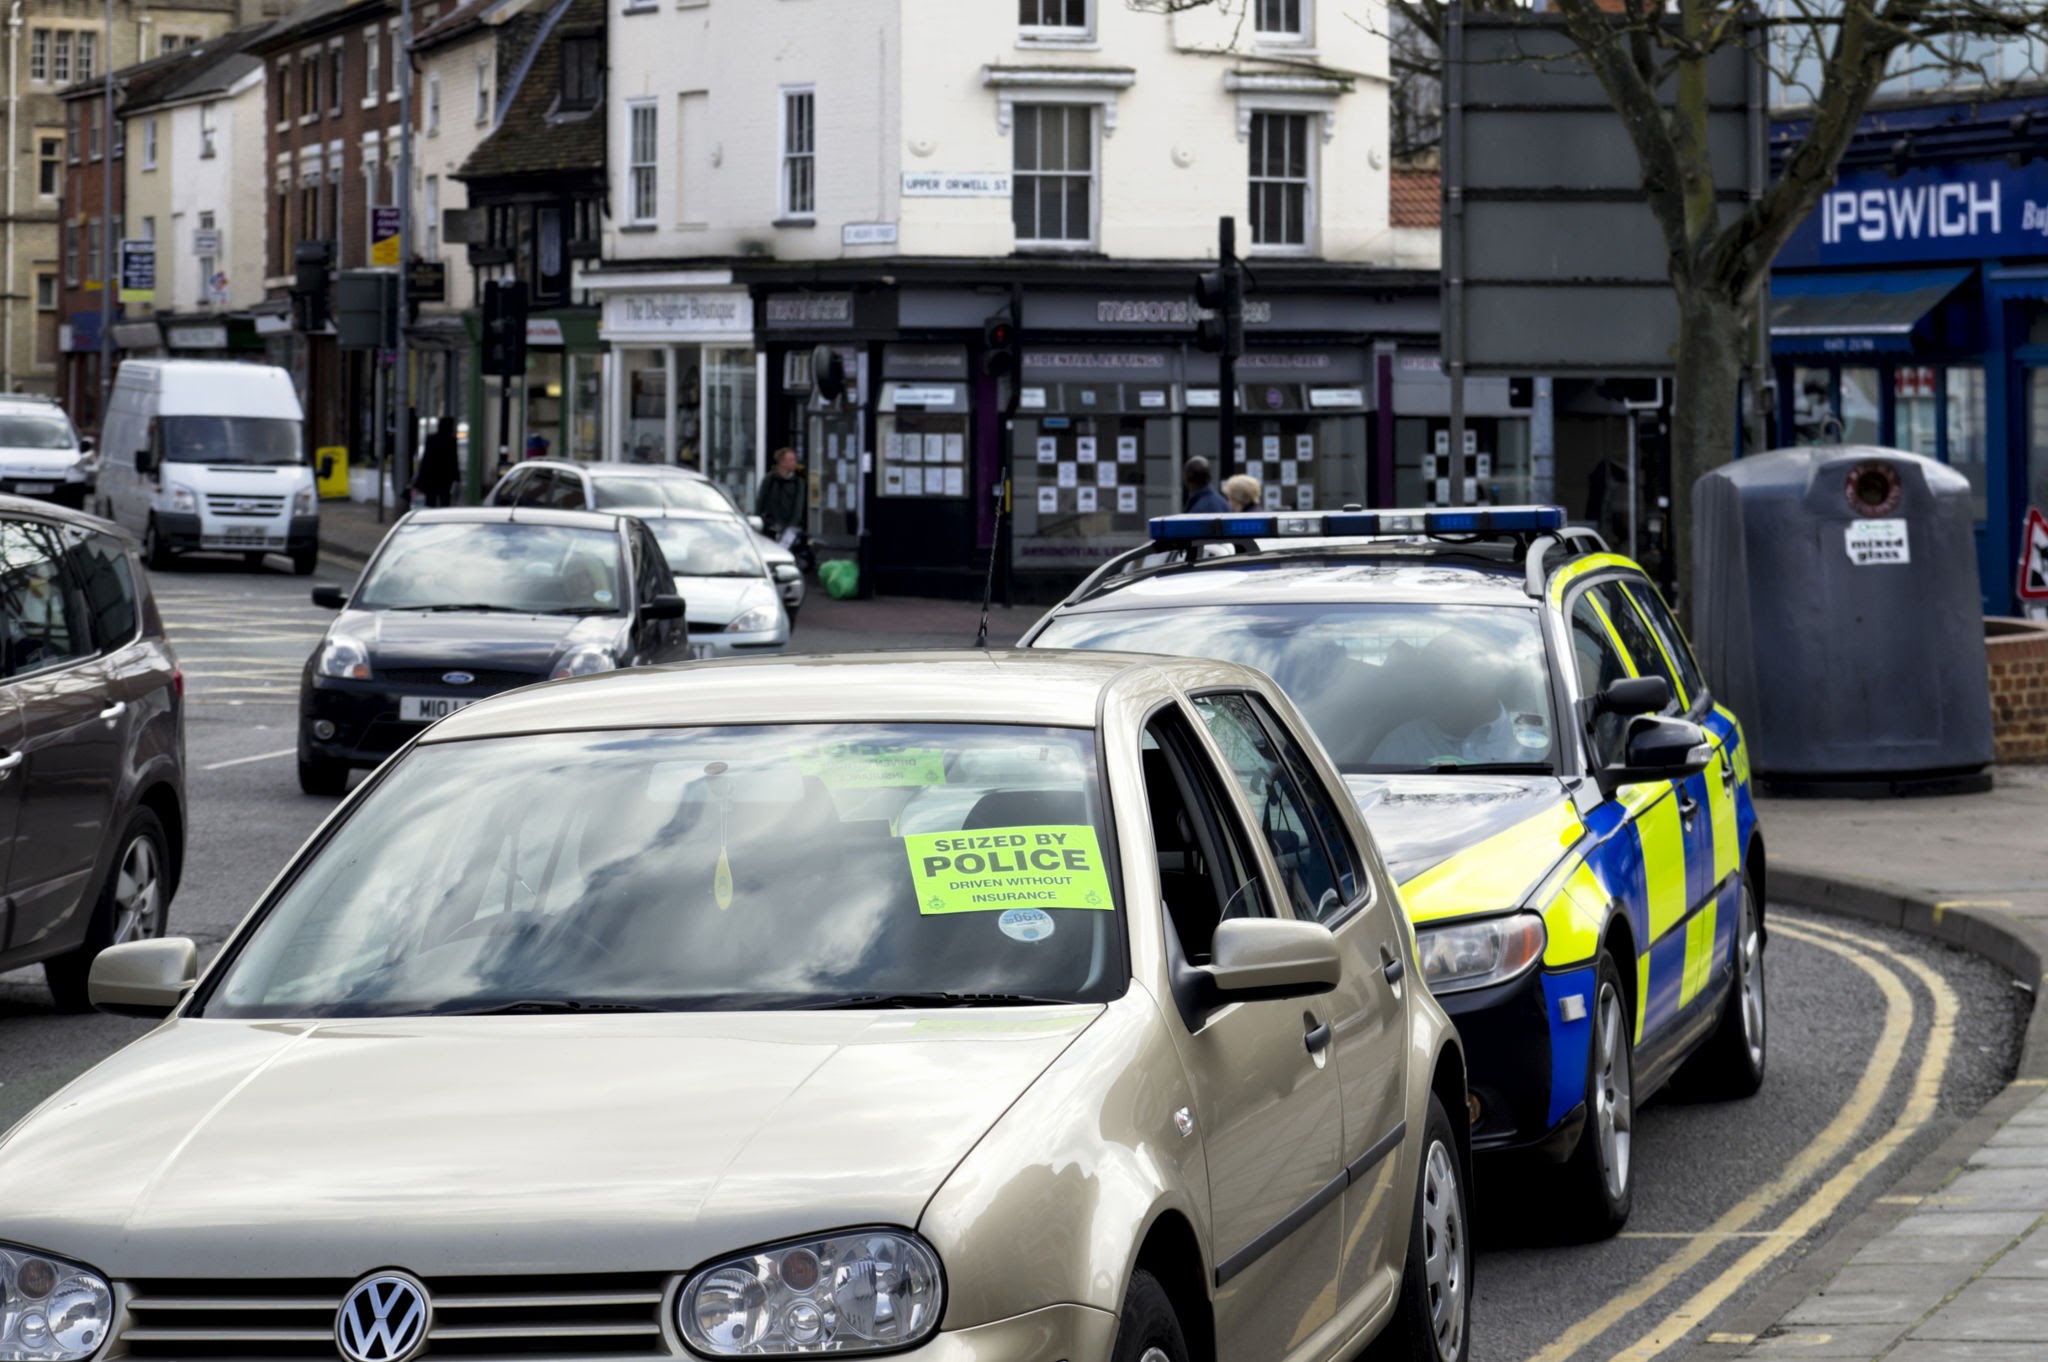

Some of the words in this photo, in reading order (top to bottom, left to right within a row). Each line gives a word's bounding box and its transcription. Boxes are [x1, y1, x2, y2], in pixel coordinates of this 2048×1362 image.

[905, 178, 940, 190] UPPER
[945, 180, 988, 191] ORWELL
[1822, 180, 2000, 243] IPSWICH
[625, 298, 643, 320] The
[645, 298, 688, 326] Designer
[690, 298, 735, 326] Boutique
[1097, 301, 1187, 322] masons
[1851, 538, 1903, 549] mixed
[1858, 550, 1899, 561] glass
[934, 834, 1026, 852] SEIZED
[1034, 833, 1068, 846] BY
[922, 849, 1091, 878] POLICE
[949, 878, 1003, 891] DRIVEN
[1005, 876, 1073, 888] WITHOUT
[971, 891, 1057, 903] INSURANCE
[1013, 912, 1032, 923] 06
